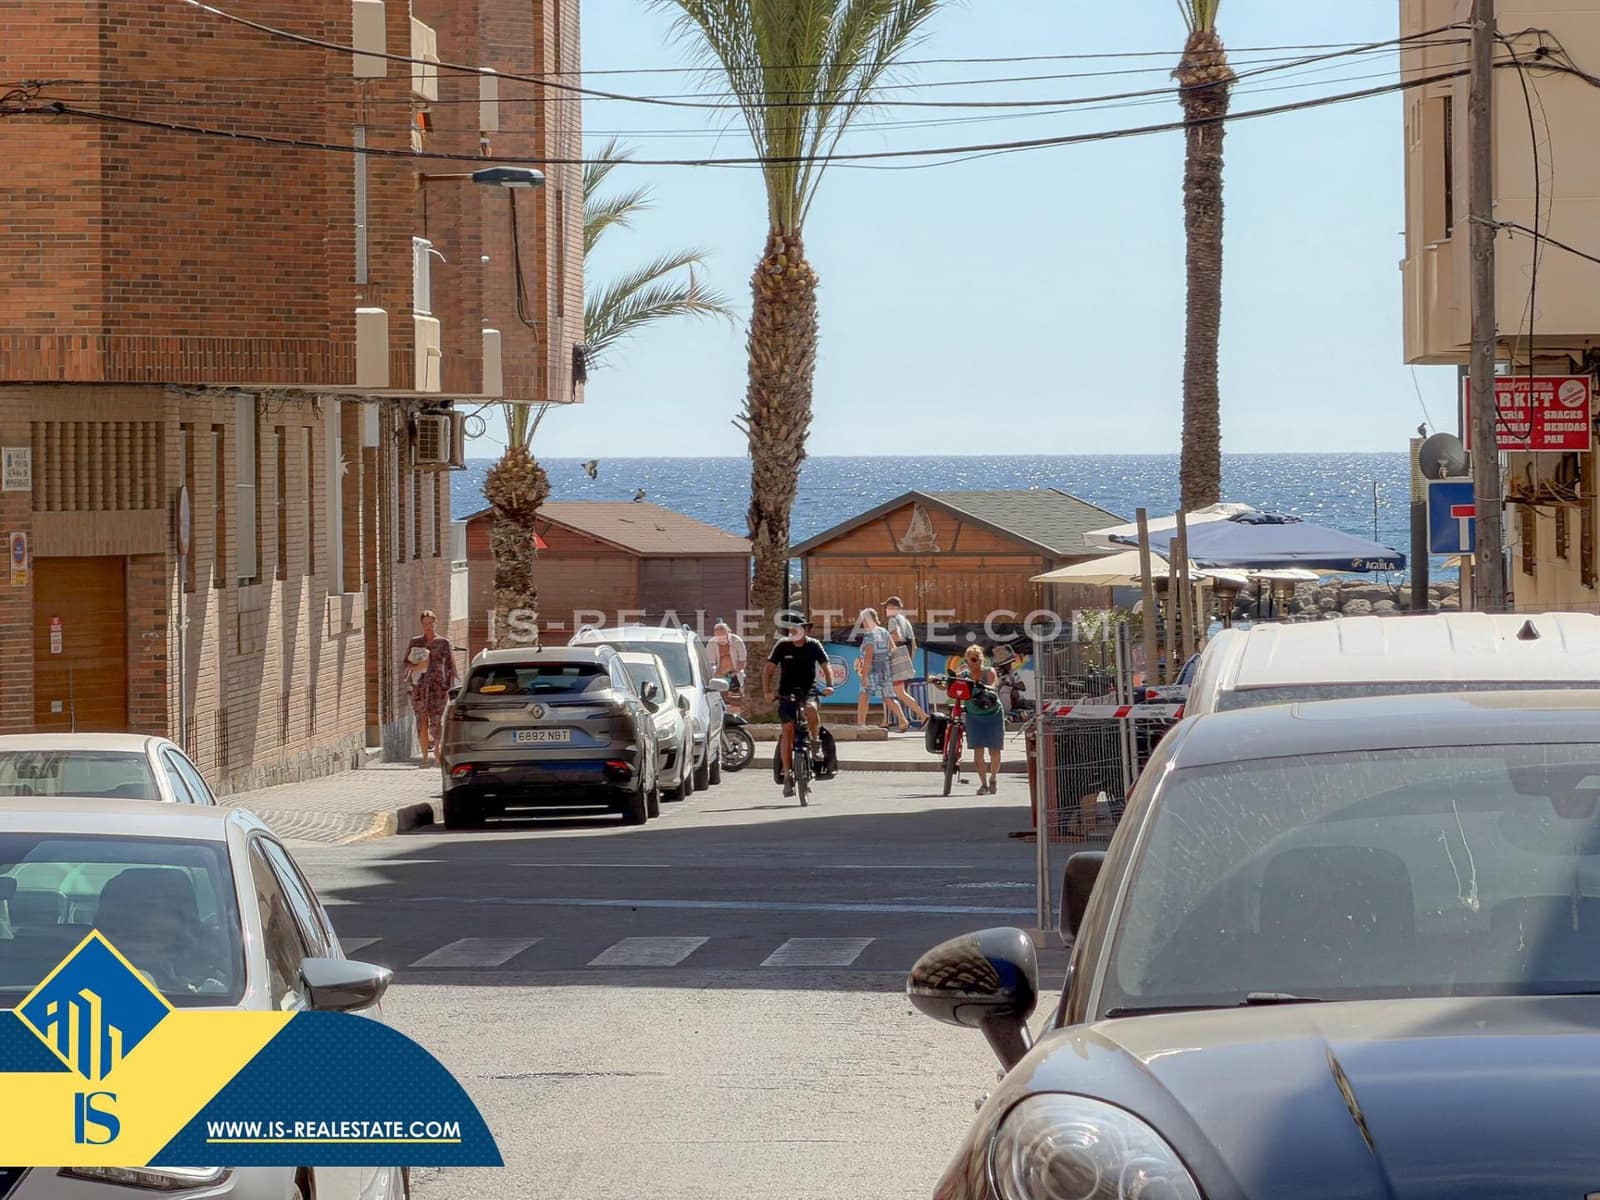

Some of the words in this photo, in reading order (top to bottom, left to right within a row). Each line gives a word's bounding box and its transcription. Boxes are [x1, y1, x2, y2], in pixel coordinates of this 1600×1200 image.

[1496, 392, 1554, 407] RKET
[1544, 410, 1584, 419] SNACKS
[1544, 423, 1588, 432] BEBIDAS
[1544, 435, 1565, 444] PAN
[518, 731, 545, 741] 6892
[548, 731, 567, 741] NBT
